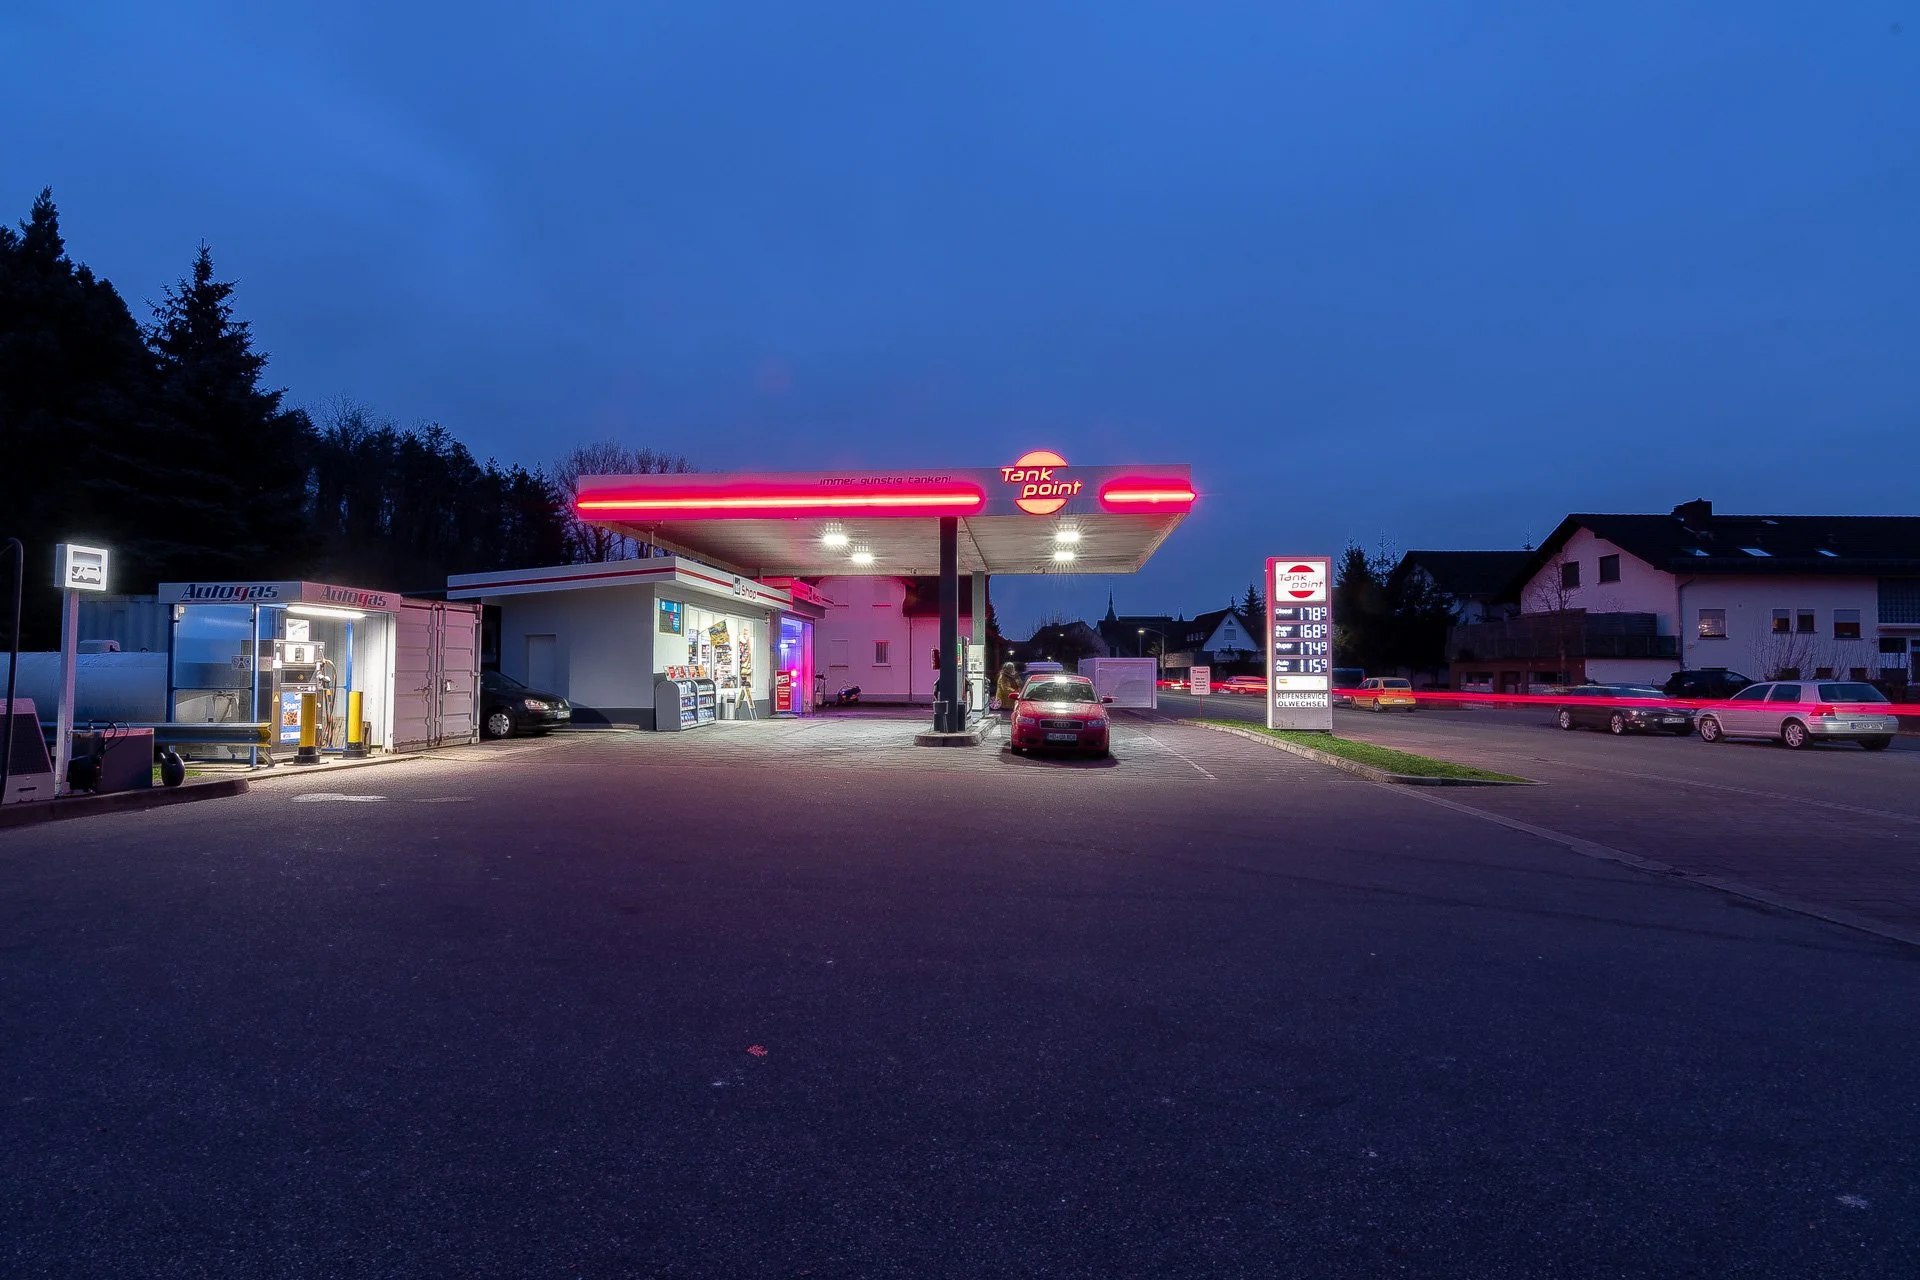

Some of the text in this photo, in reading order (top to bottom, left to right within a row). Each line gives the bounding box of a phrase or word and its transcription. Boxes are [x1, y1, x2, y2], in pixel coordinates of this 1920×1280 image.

[1001, 466, 1053, 482] Tank
[860, 476, 903, 486] günstig
[907, 475, 952, 484] tanken!
[1022, 480, 1082, 499] point
[1279, 573, 1307, 581] Tank
[1291, 580, 1324, 589] point
[180, 583, 280, 602] Autogas
[319, 585, 388, 608] Autogas
[1275, 642, 1293, 650] Super
[1277, 692, 1326, 700] REIFENSERVICE
